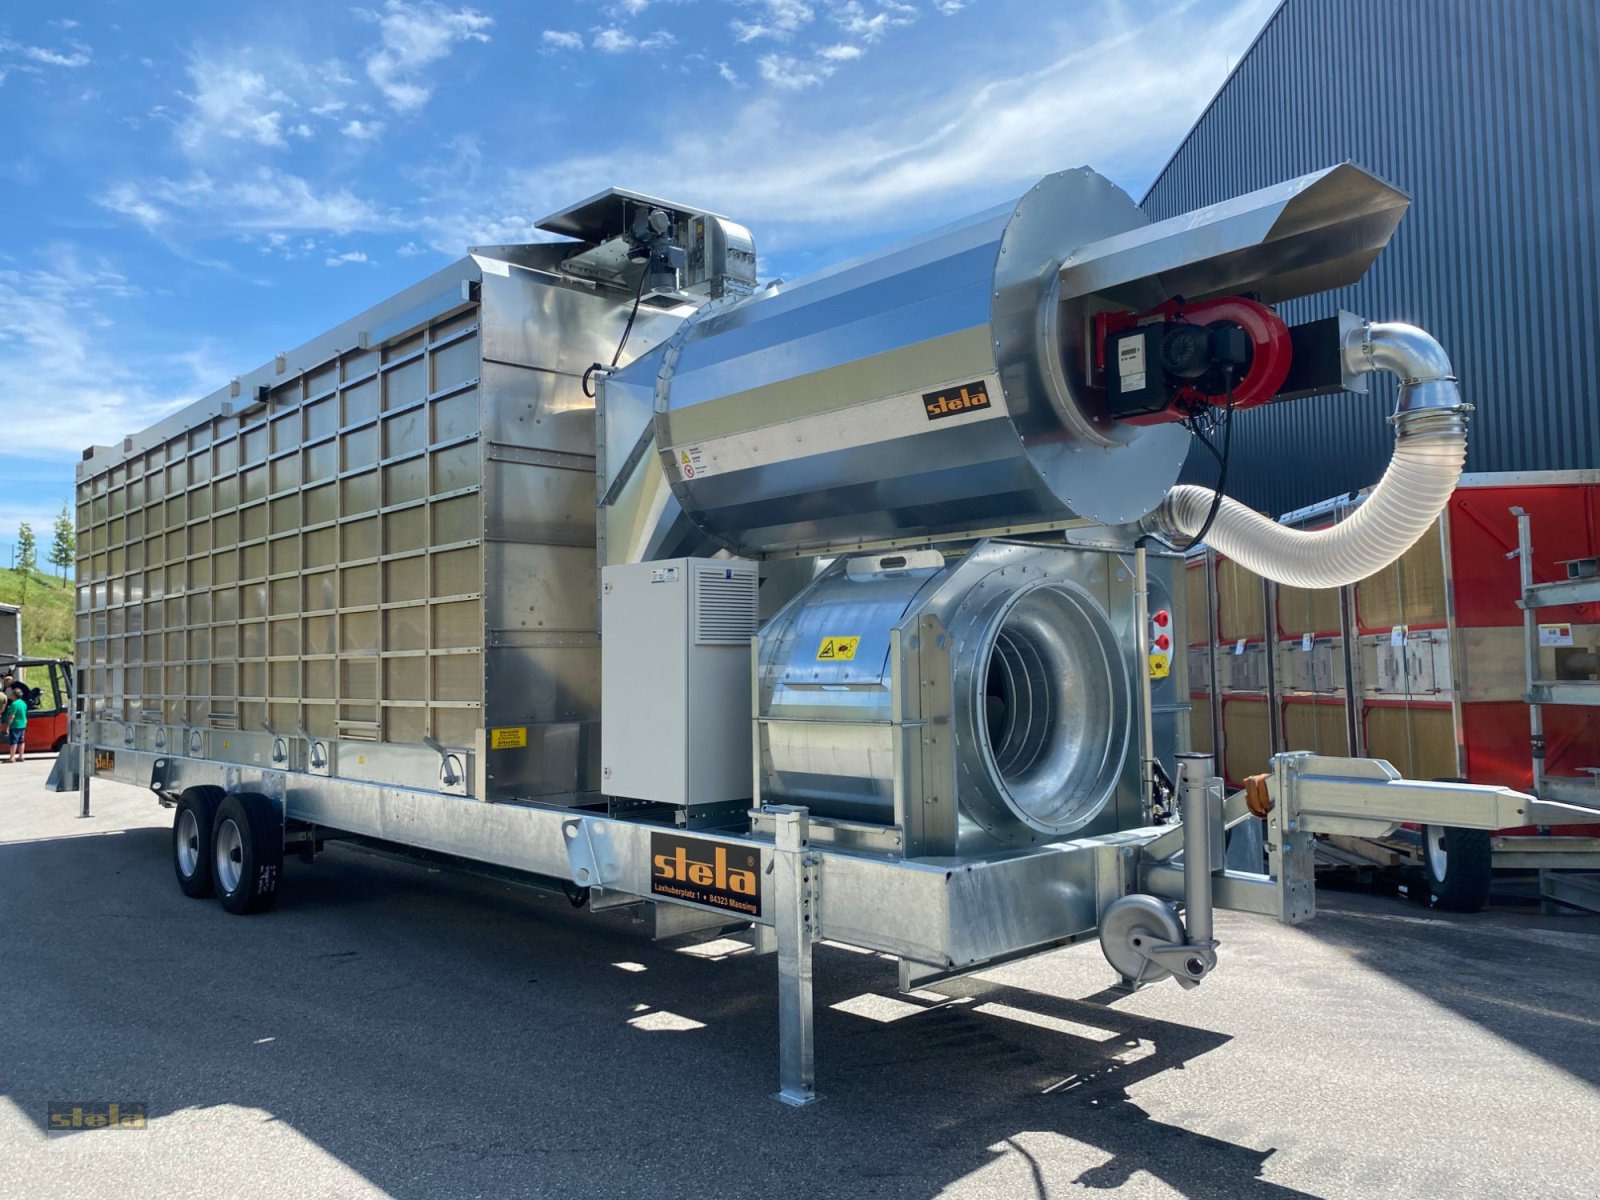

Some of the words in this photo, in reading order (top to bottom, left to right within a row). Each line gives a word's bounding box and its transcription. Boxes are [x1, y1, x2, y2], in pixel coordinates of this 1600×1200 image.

[927, 388, 987, 415] stela
[709, 894, 728, 905] 84323
[729, 899, 757, 913] Massing
